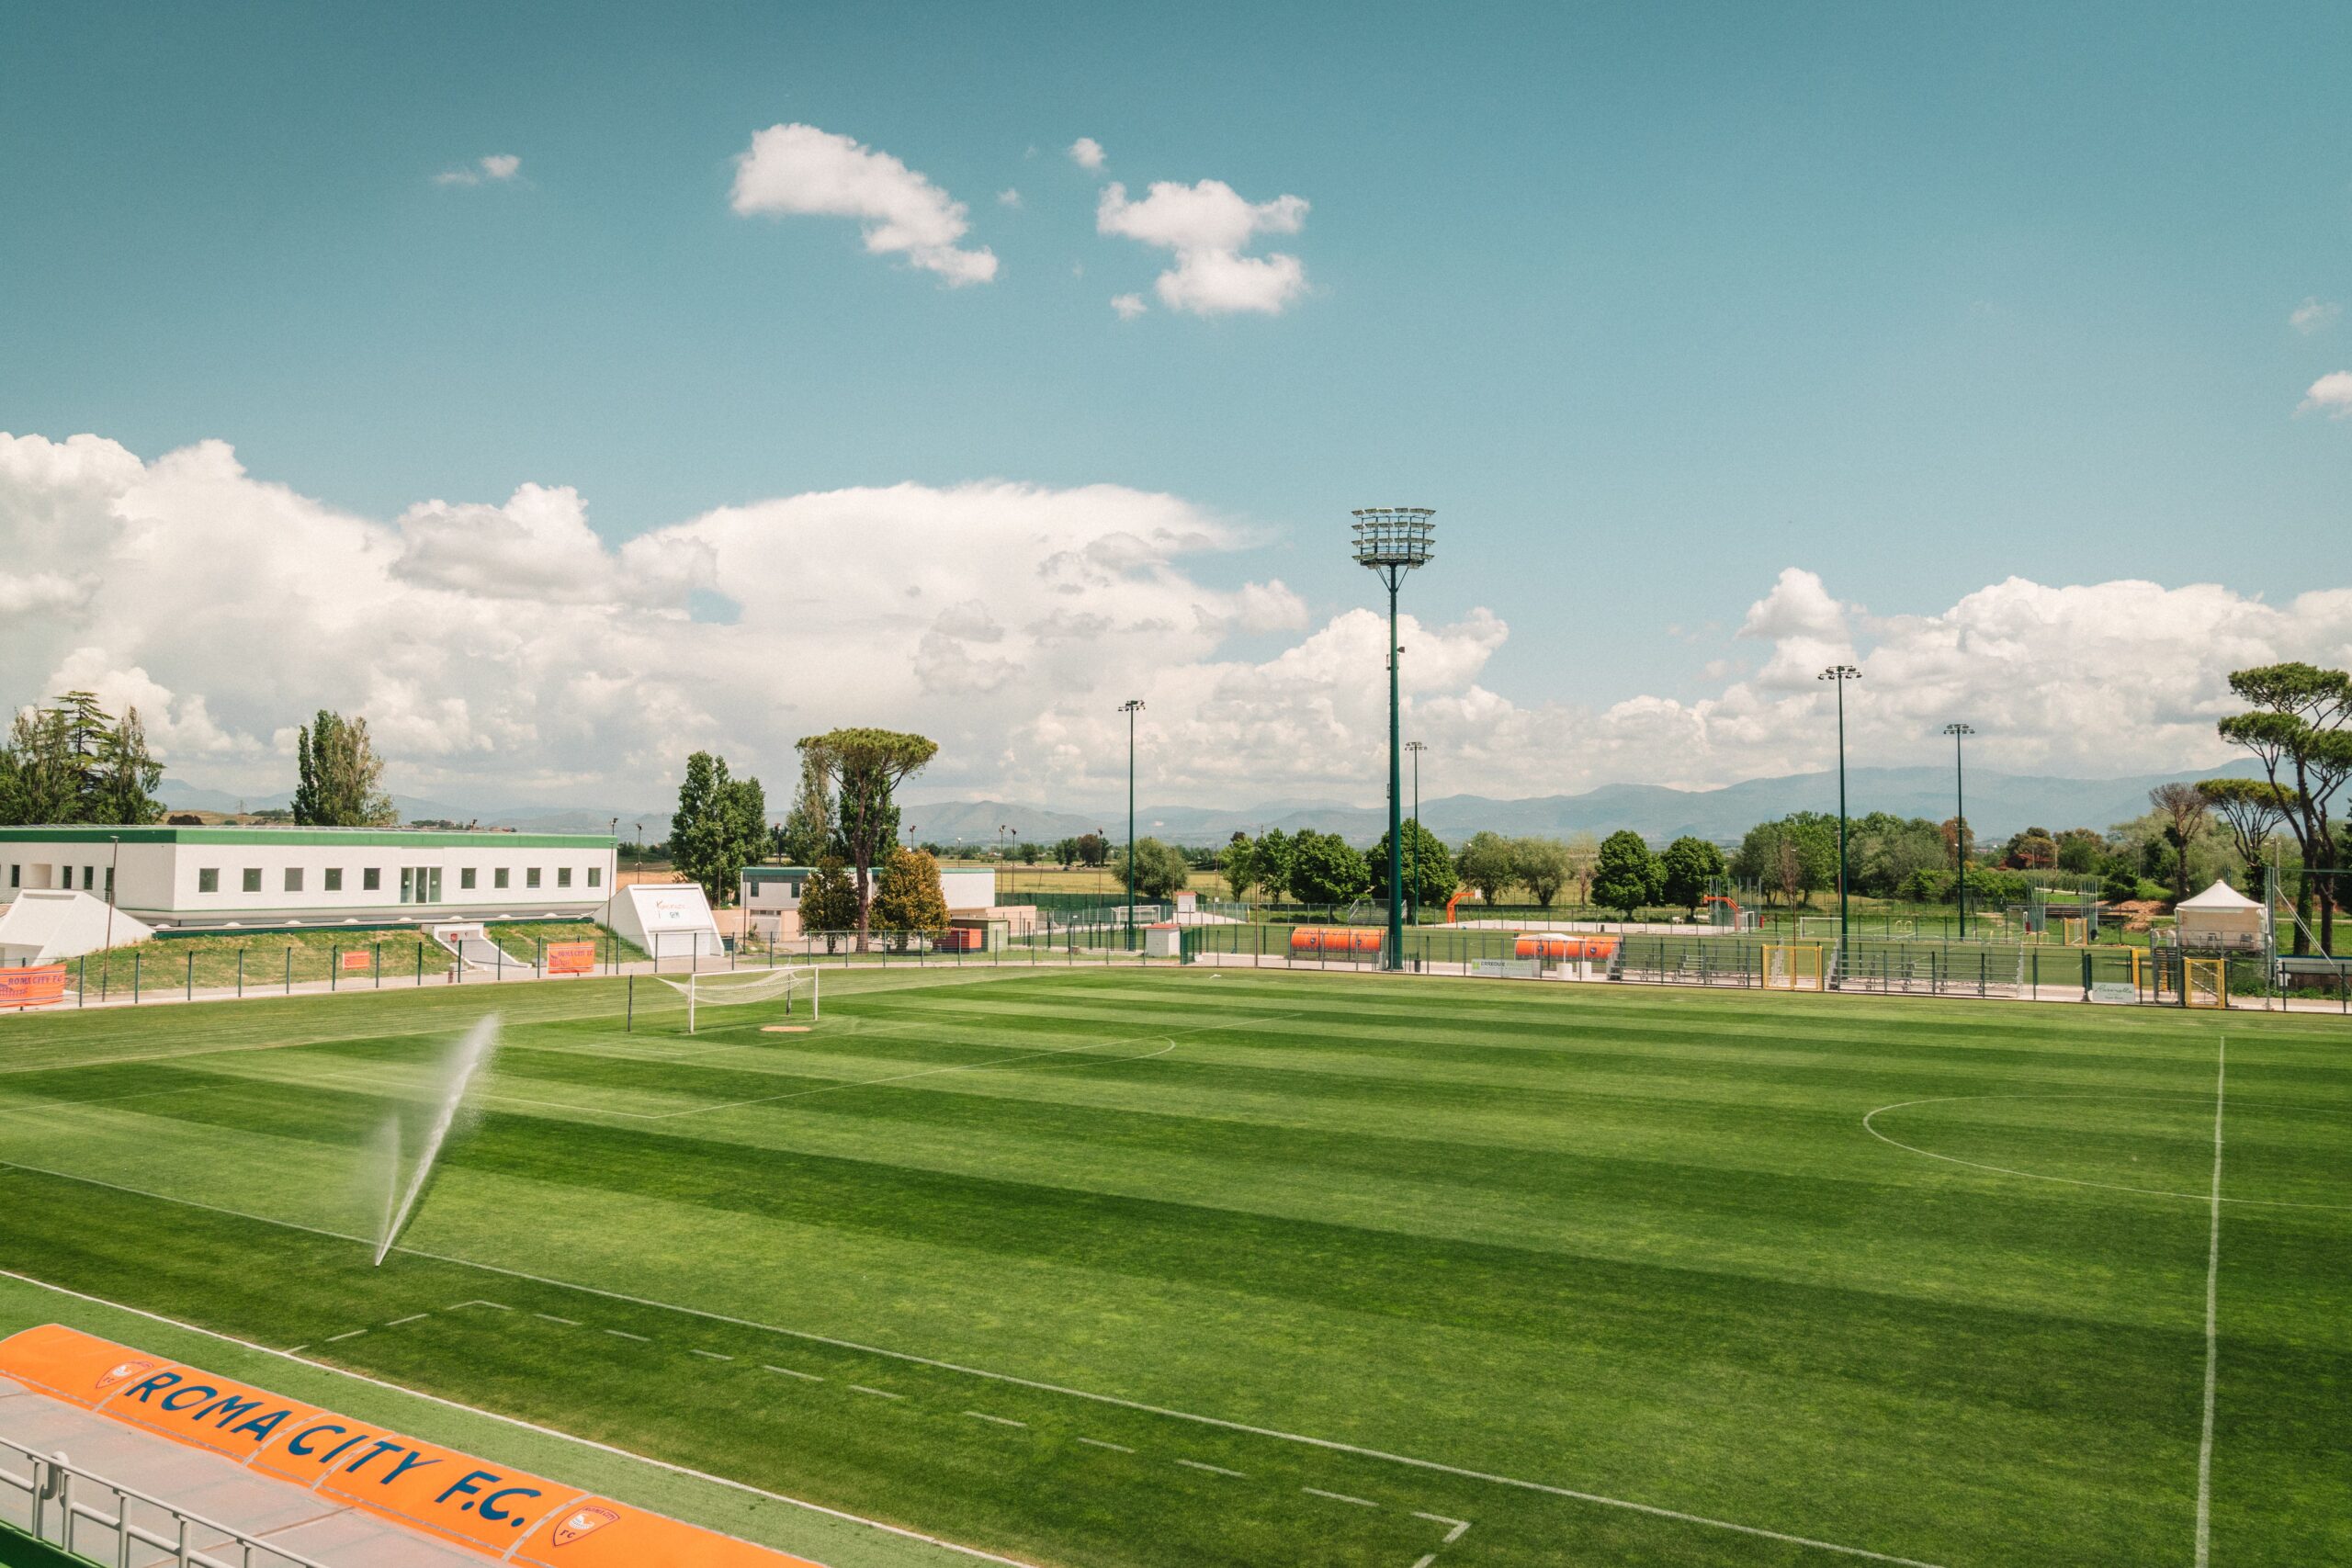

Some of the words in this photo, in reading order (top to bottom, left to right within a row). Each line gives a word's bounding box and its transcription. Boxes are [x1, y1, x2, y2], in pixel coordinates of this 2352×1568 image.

[8, 976, 30, 986] ROMA
[33, 976, 50, 984] CITY
[52, 975, 62, 983] FC
[123, 1372, 292, 1442] ROMA
[288, 1425, 443, 1485] CITY
[435, 1470, 542, 1528] F.C.
[560, 1529, 576, 1539] FC
